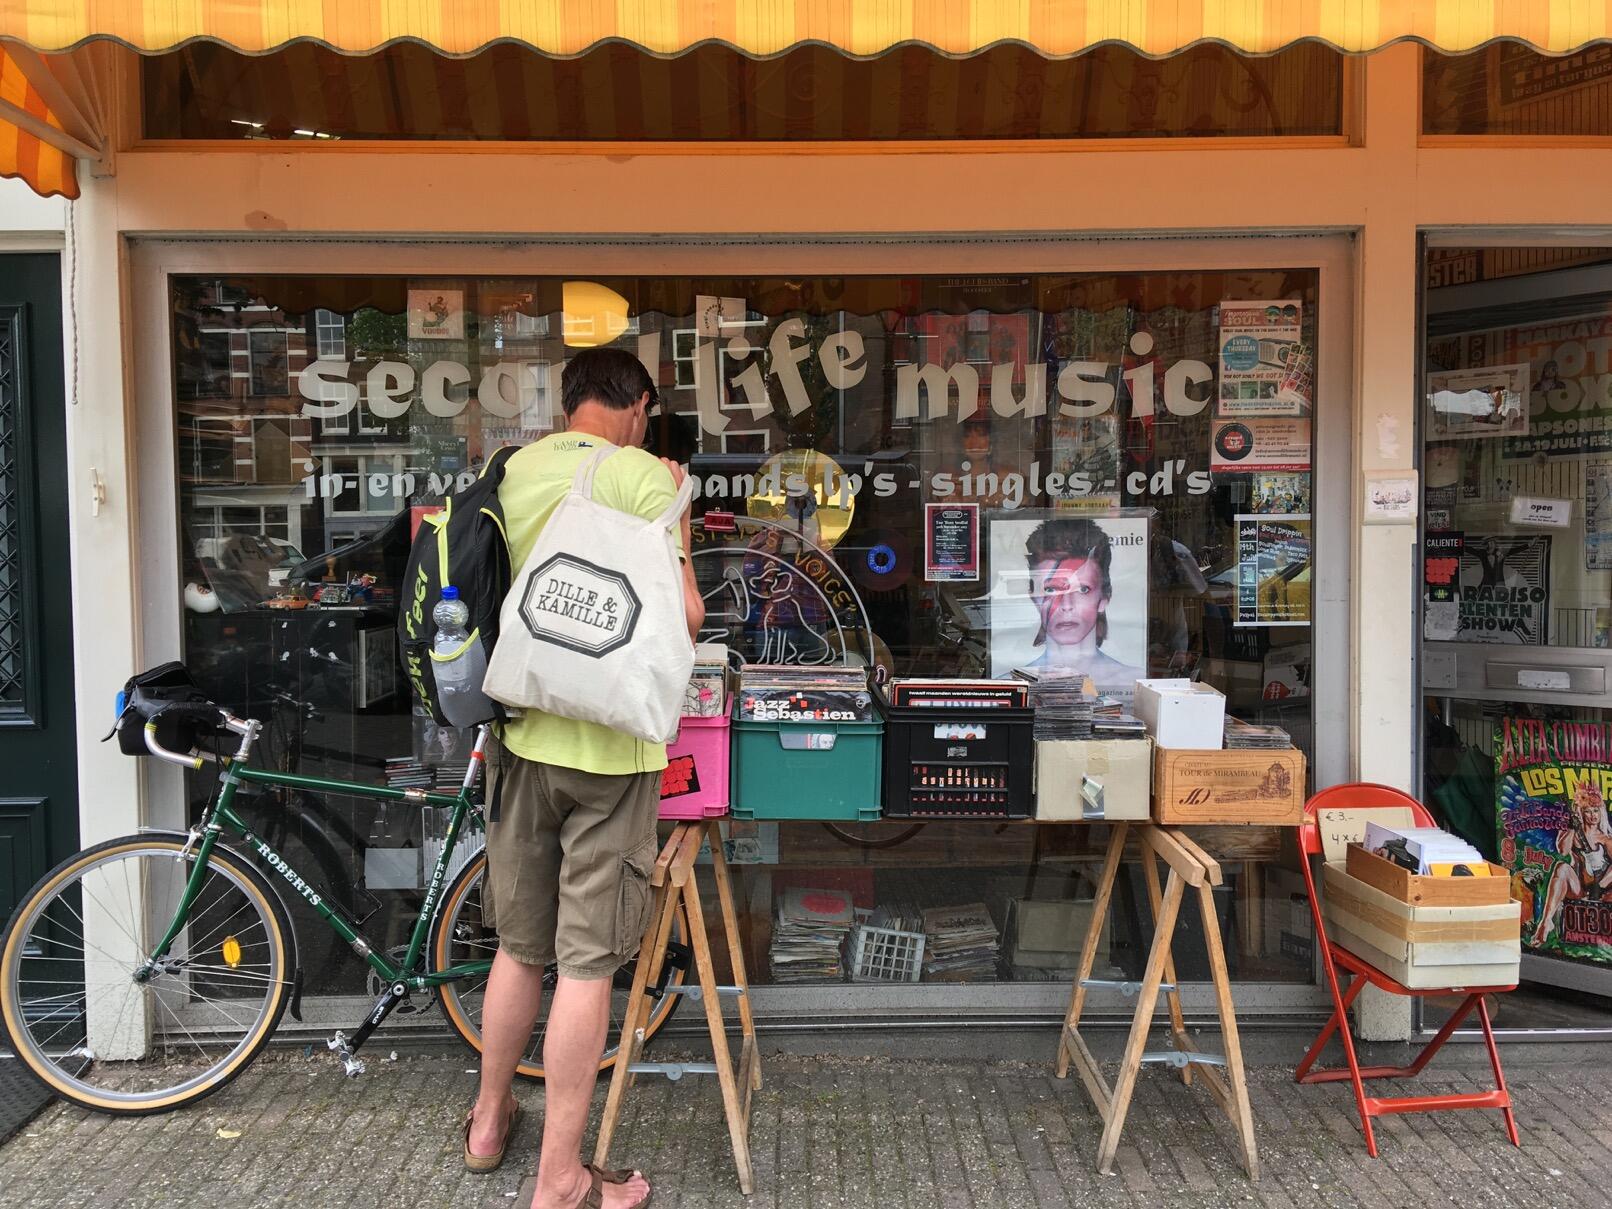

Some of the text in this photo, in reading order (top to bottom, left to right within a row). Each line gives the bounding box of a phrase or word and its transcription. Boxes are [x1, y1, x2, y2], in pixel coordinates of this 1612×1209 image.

[1517, 338, 1612, 385] HOT
[691, 318, 867, 436] life
[896, 332, 1213, 424] music
[1551, 435, 1583, 451] JULI
[368, 472, 415, 498] en
[824, 461, 898, 510] lp's
[931, 460, 1093, 510] singles
[1126, 459, 1212, 497] cd's
[1531, 504, 1553, 513] open
[1107, 532, 1144, 547] emie
[1261, 524, 1276, 533] Soul
[546, 578, 618, 614] DILLE &
[536, 594, 618, 632] KAMILLE
[1461, 616, 1517, 633] SHOW
[744, 696, 790, 710] Jazz
[1097, 689, 1124, 698] agazine
[753, 707, 856, 722] Sebastien
[1550, 720, 1612, 766] CUMBI
[1180, 768, 1261, 778] TOUR de MIRAMBEAU
[1520, 767, 1565, 798] LOS
[1501, 838, 1517, 863] 8
[257, 842, 322, 906] ROBERTS
[420, 861, 446, 922] ROBERTS
